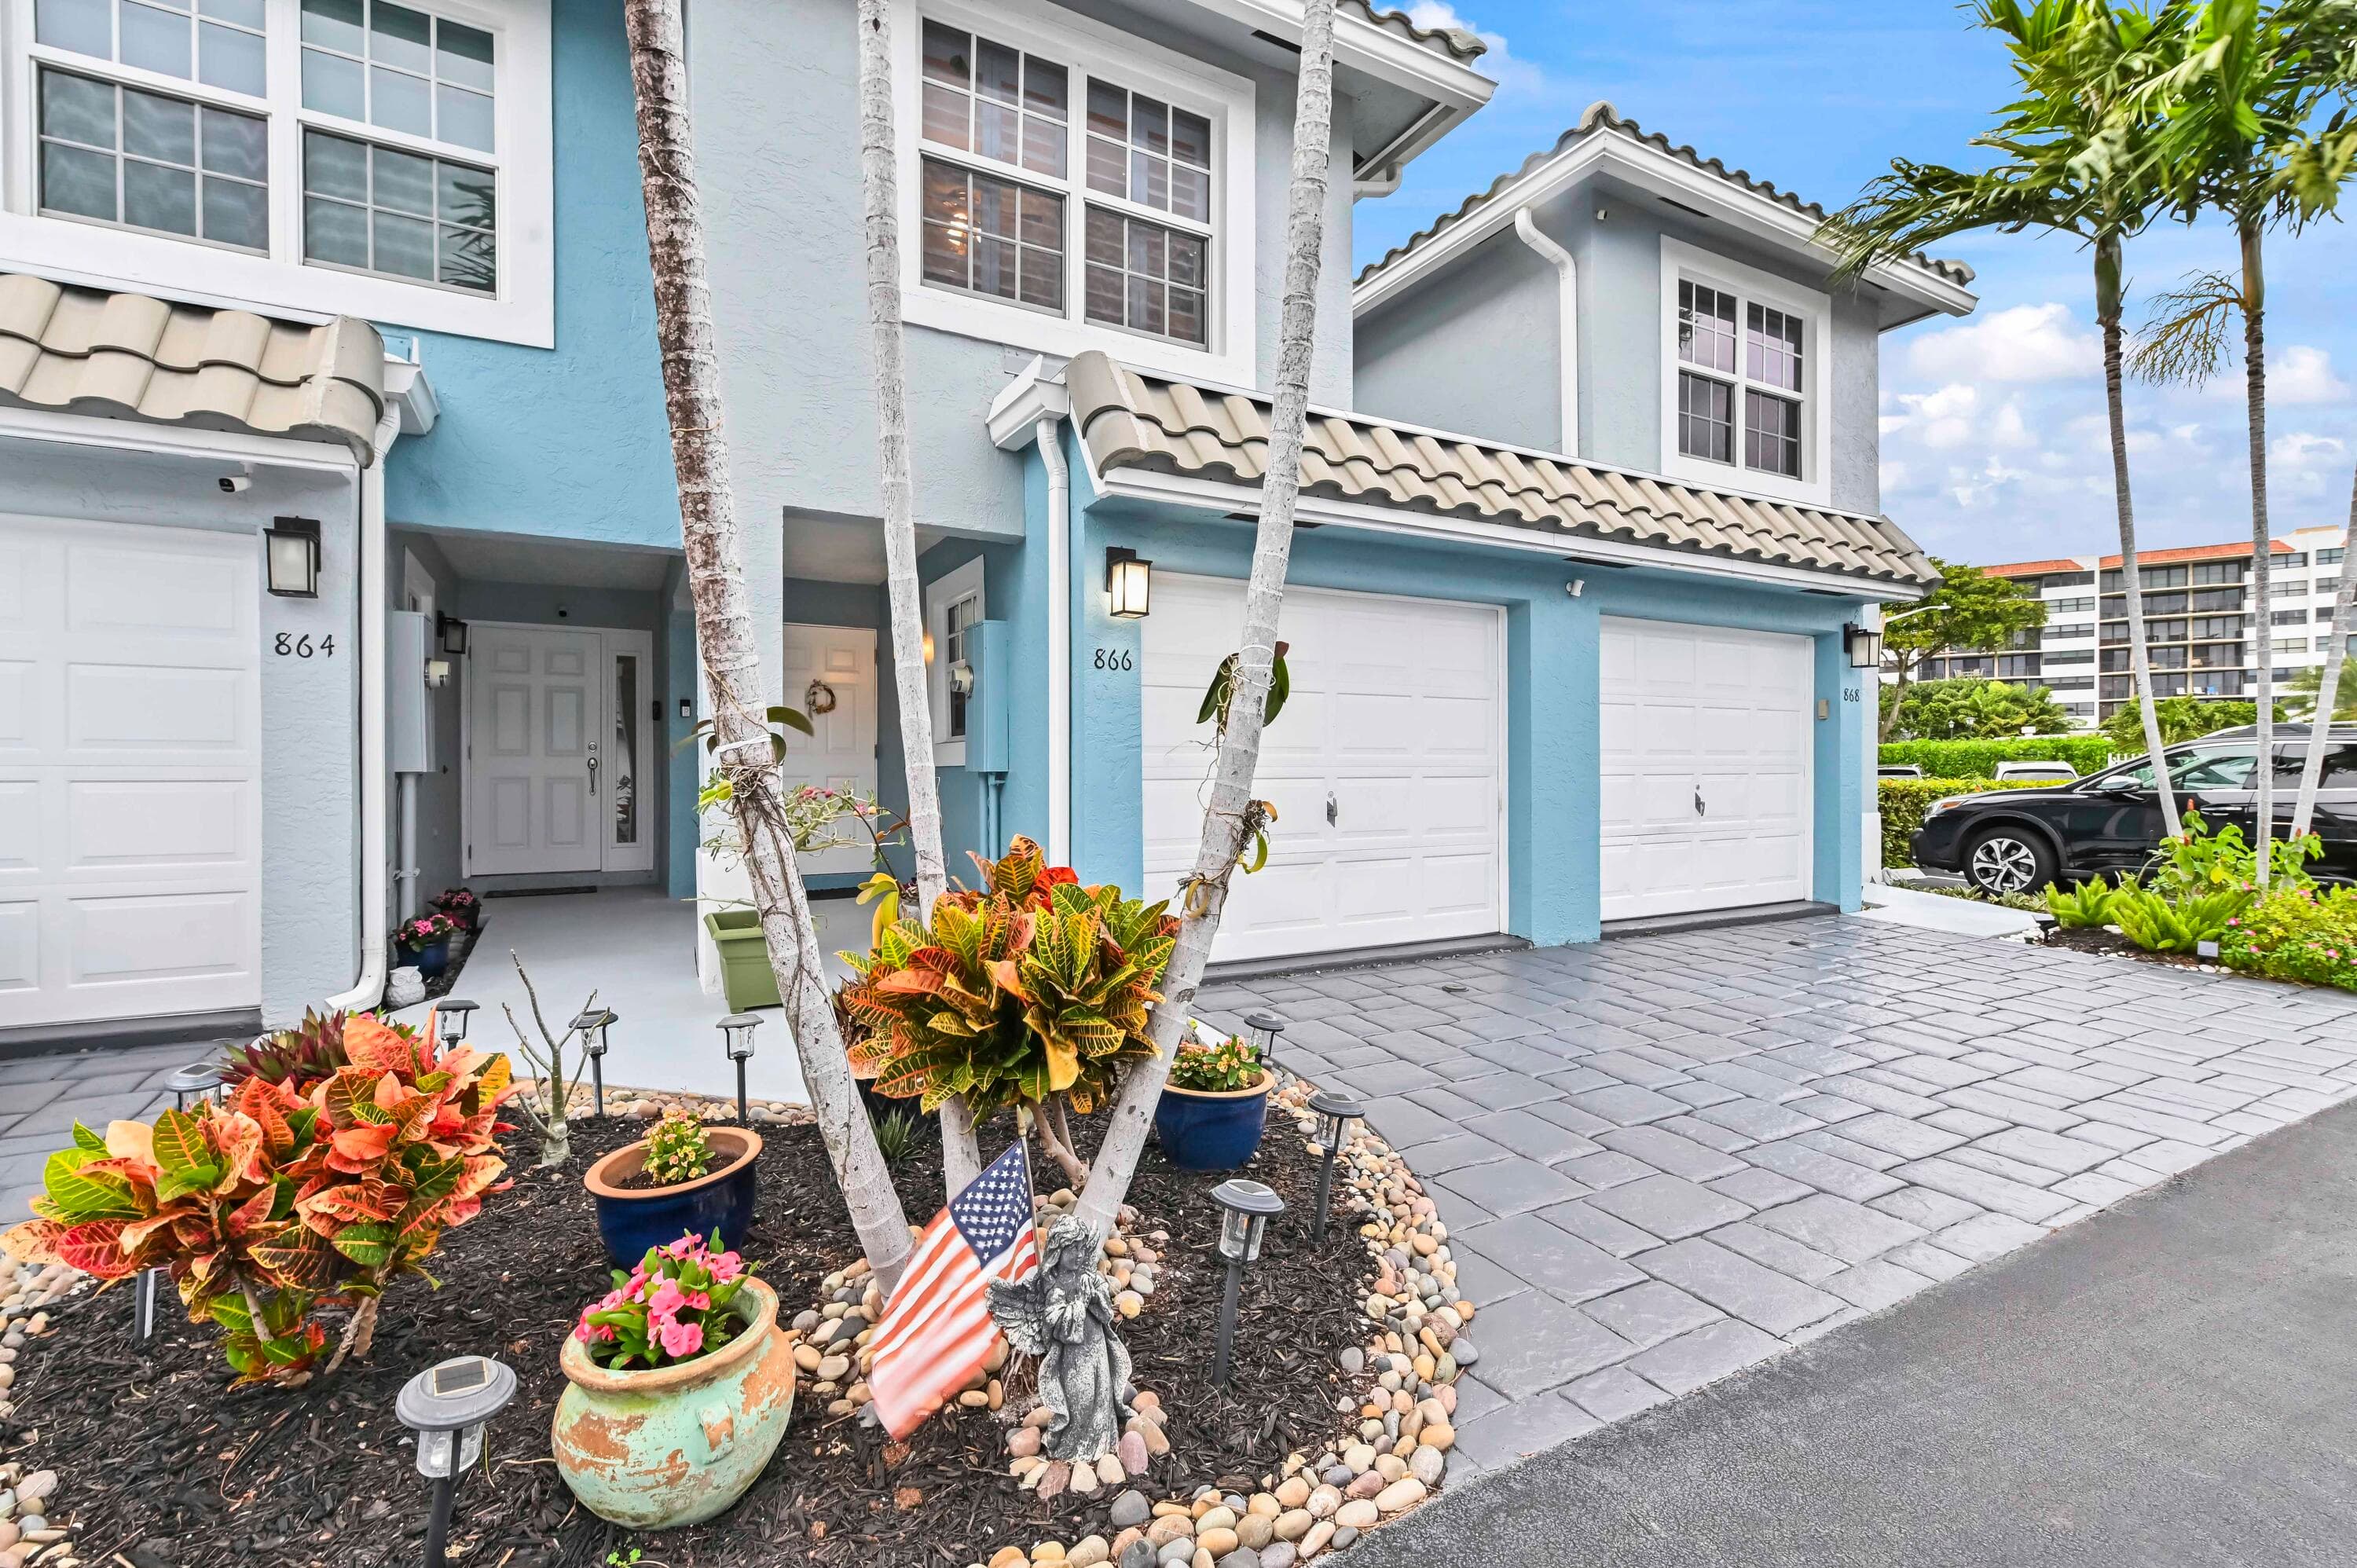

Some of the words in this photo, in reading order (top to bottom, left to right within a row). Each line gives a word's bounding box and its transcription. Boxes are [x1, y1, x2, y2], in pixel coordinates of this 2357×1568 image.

[274, 632, 335, 658] 864
[1094, 648, 1132, 671] 866
[1843, 687, 1860, 702] 868
